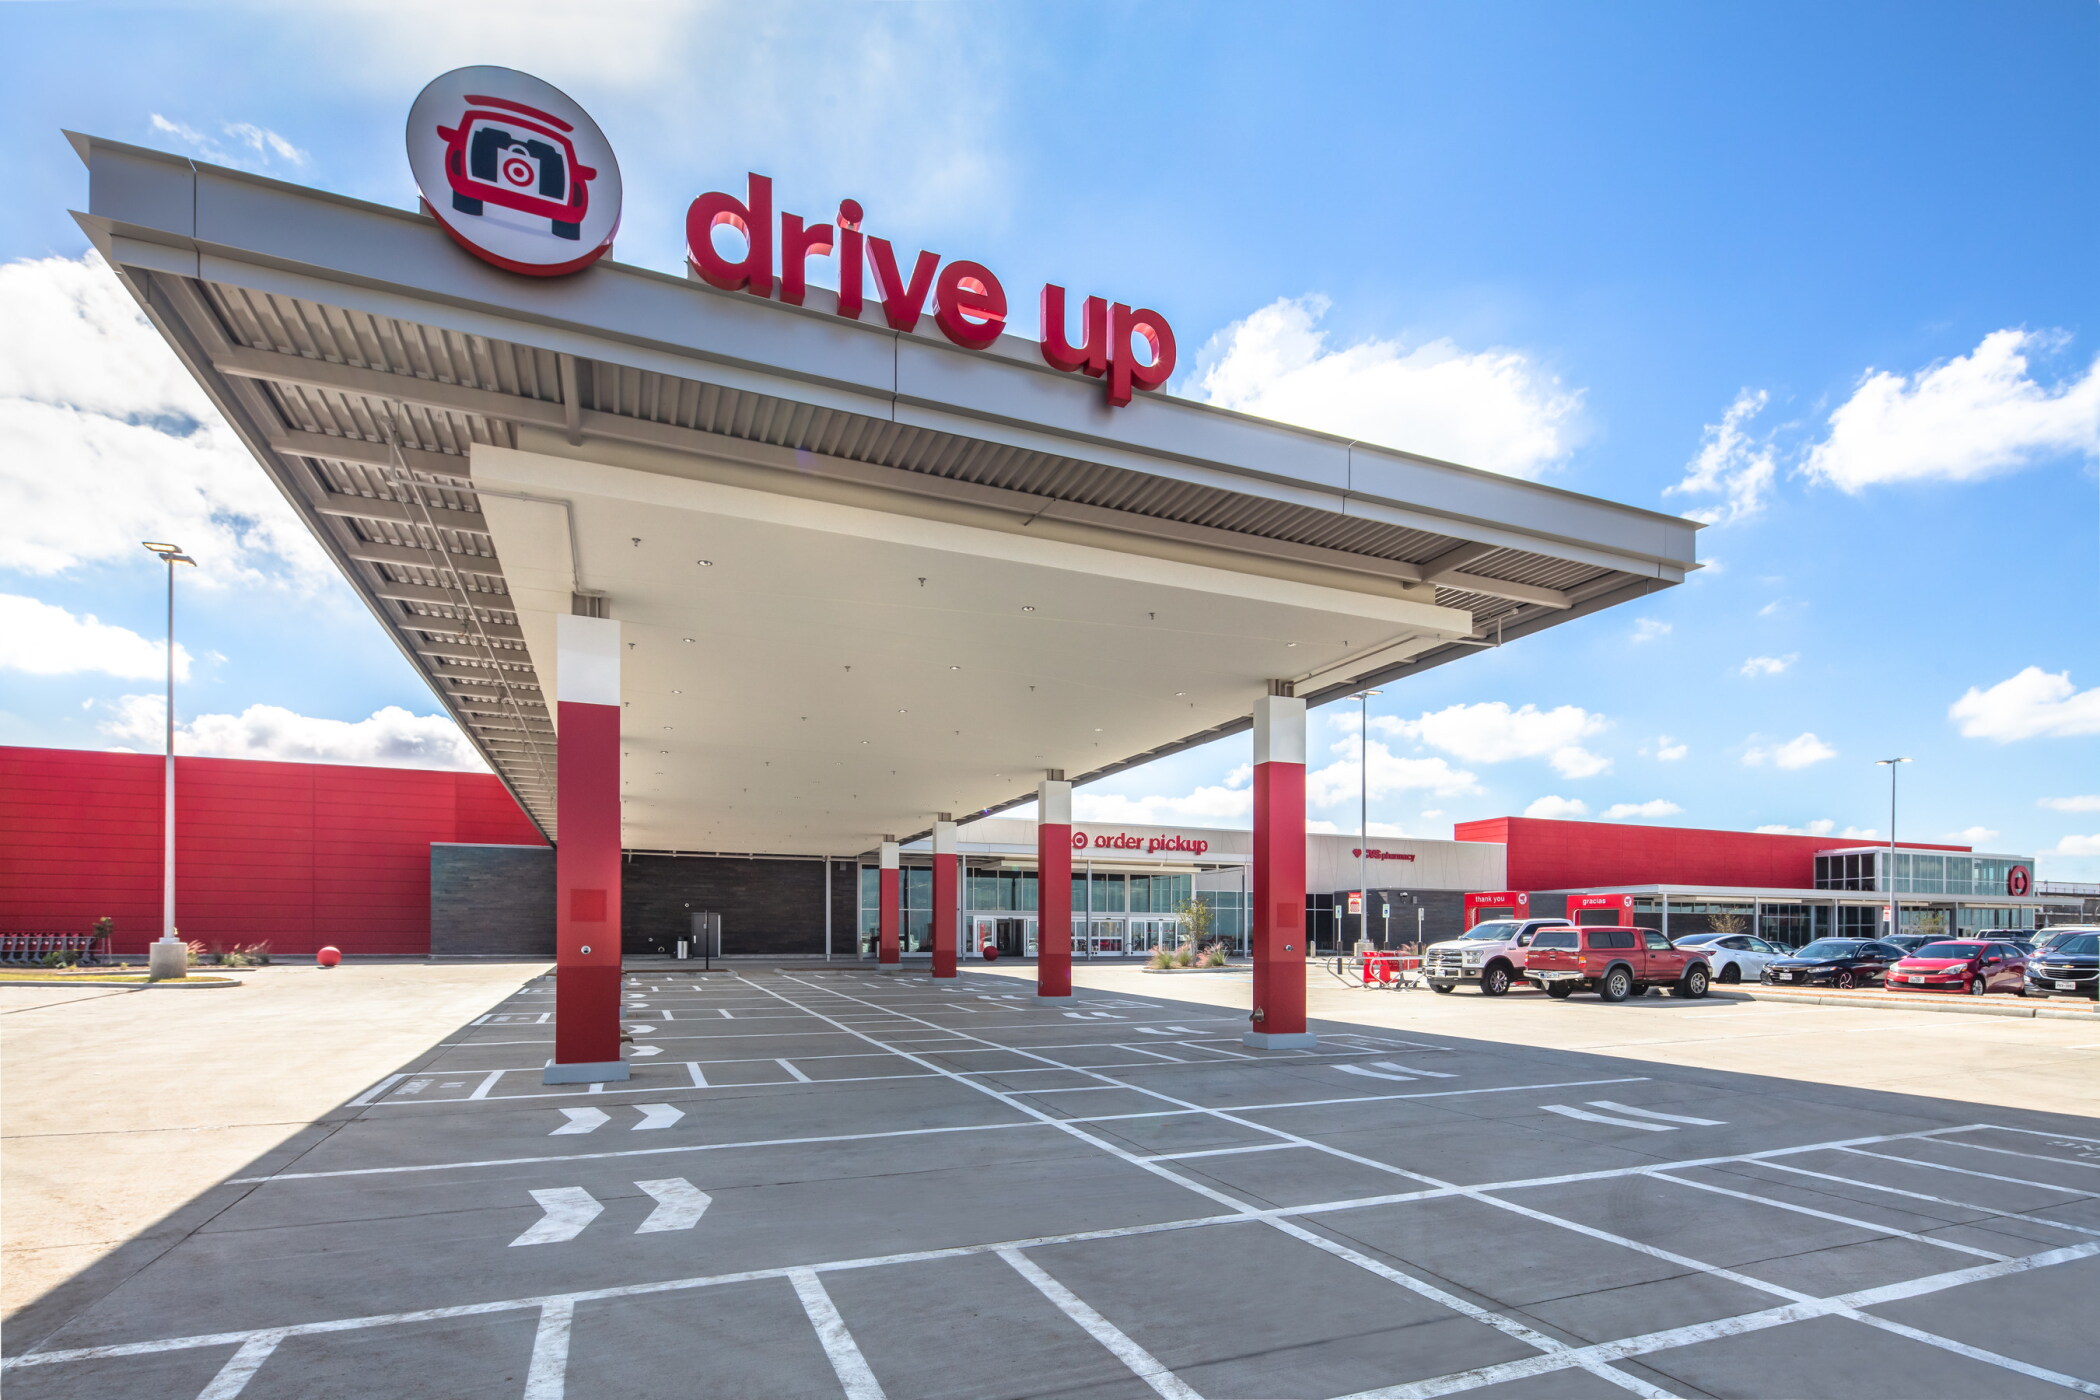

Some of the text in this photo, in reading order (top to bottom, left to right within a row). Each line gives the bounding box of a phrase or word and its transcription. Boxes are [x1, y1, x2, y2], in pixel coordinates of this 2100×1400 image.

[686, 171, 1177, 408] drive up
[1094, 832, 1208, 855] order pickup
[1381, 852, 1415, 862] pharmacy
[1493, 895, 1505, 904] you
